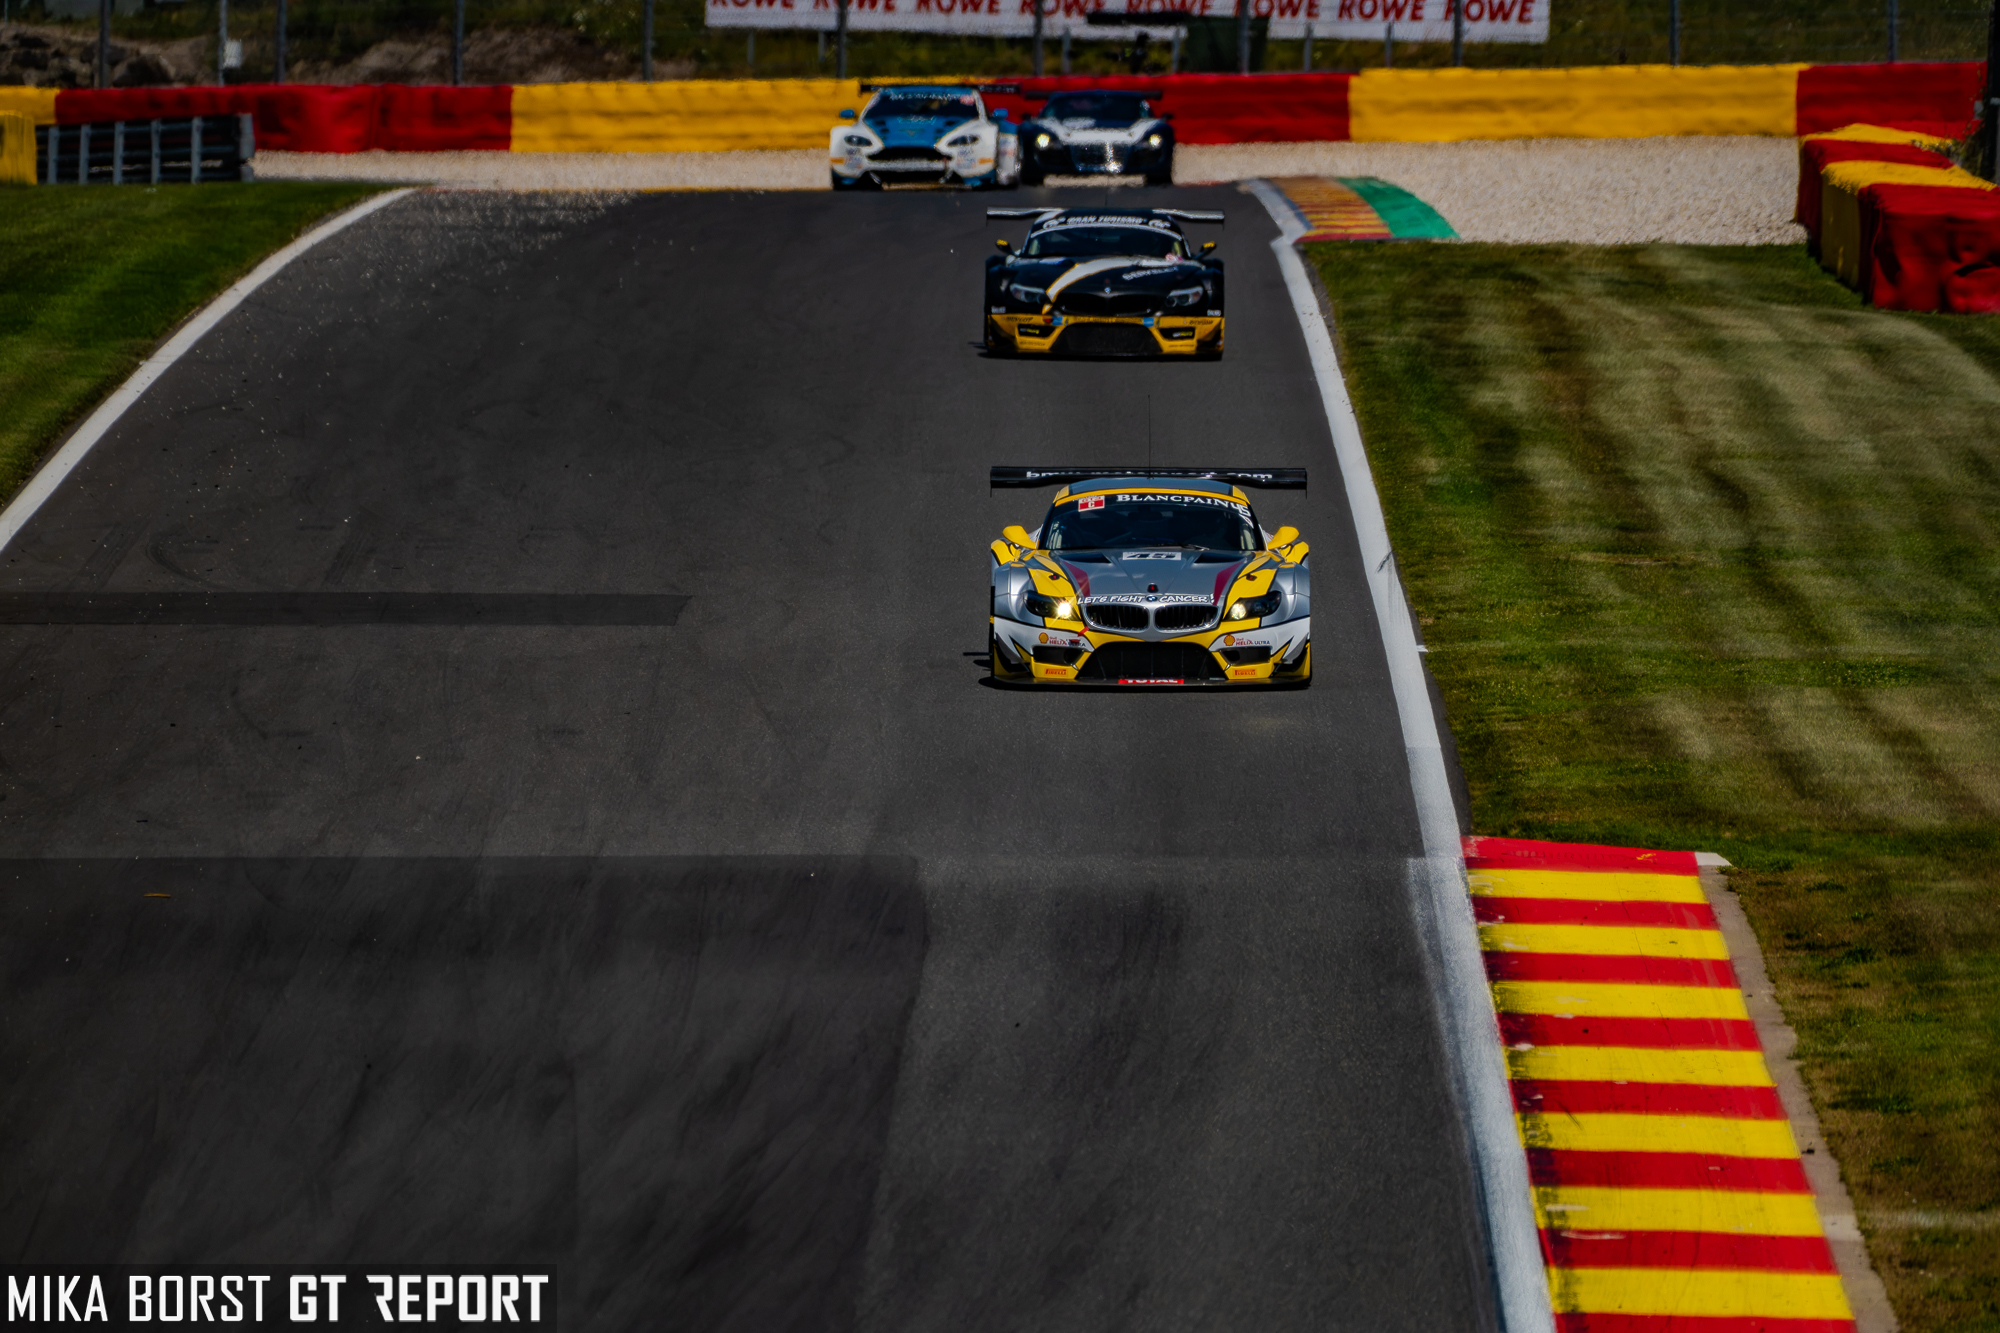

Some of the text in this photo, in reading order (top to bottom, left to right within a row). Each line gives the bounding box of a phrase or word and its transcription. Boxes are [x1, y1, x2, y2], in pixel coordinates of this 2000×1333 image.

[1233, 0, 1320, 19] OWE
[1337, 0, 1425, 21] ROWE
[1116, 494, 1230, 508] BLANCPAIN
[1230, 502, 1252, 517] 45
